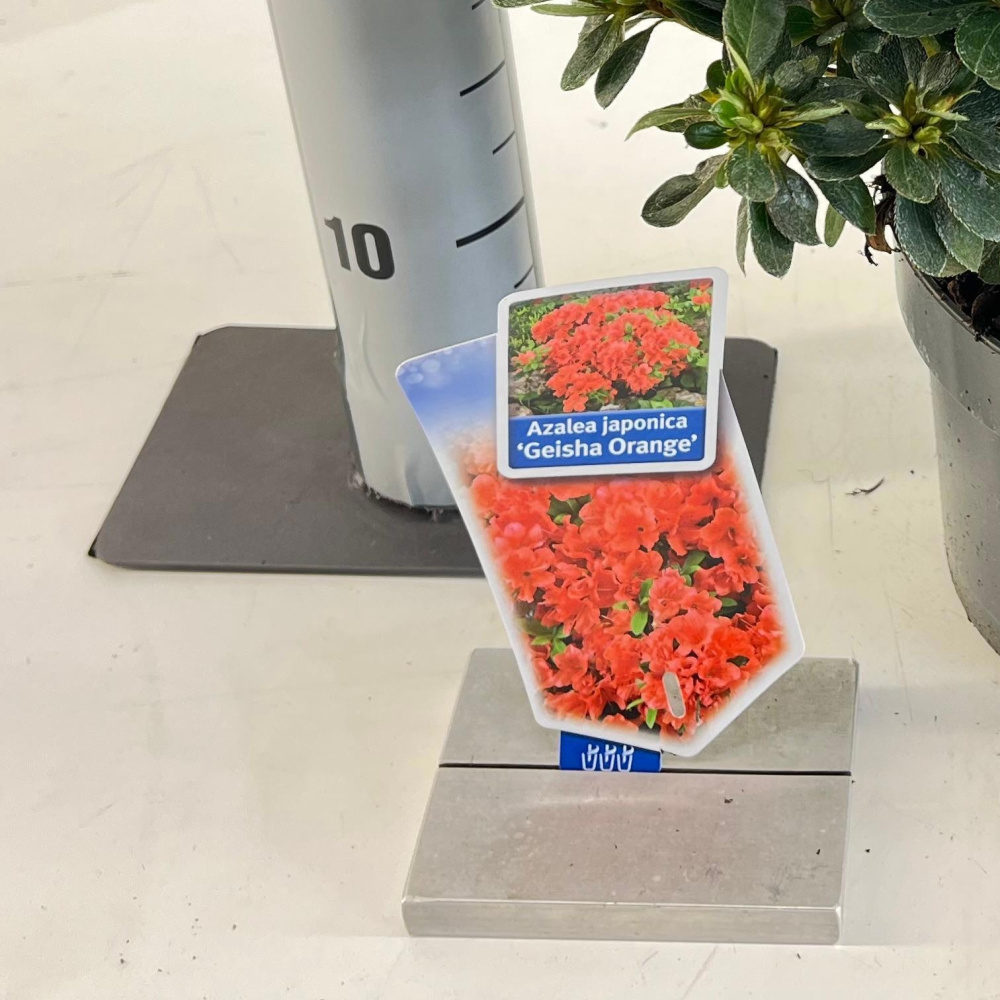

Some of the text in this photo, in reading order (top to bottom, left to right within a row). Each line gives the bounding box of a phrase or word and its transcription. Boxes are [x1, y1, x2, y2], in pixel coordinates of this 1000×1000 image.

[324, 216, 395, 280] 10
[526, 413, 688, 437] Azalea japonica
